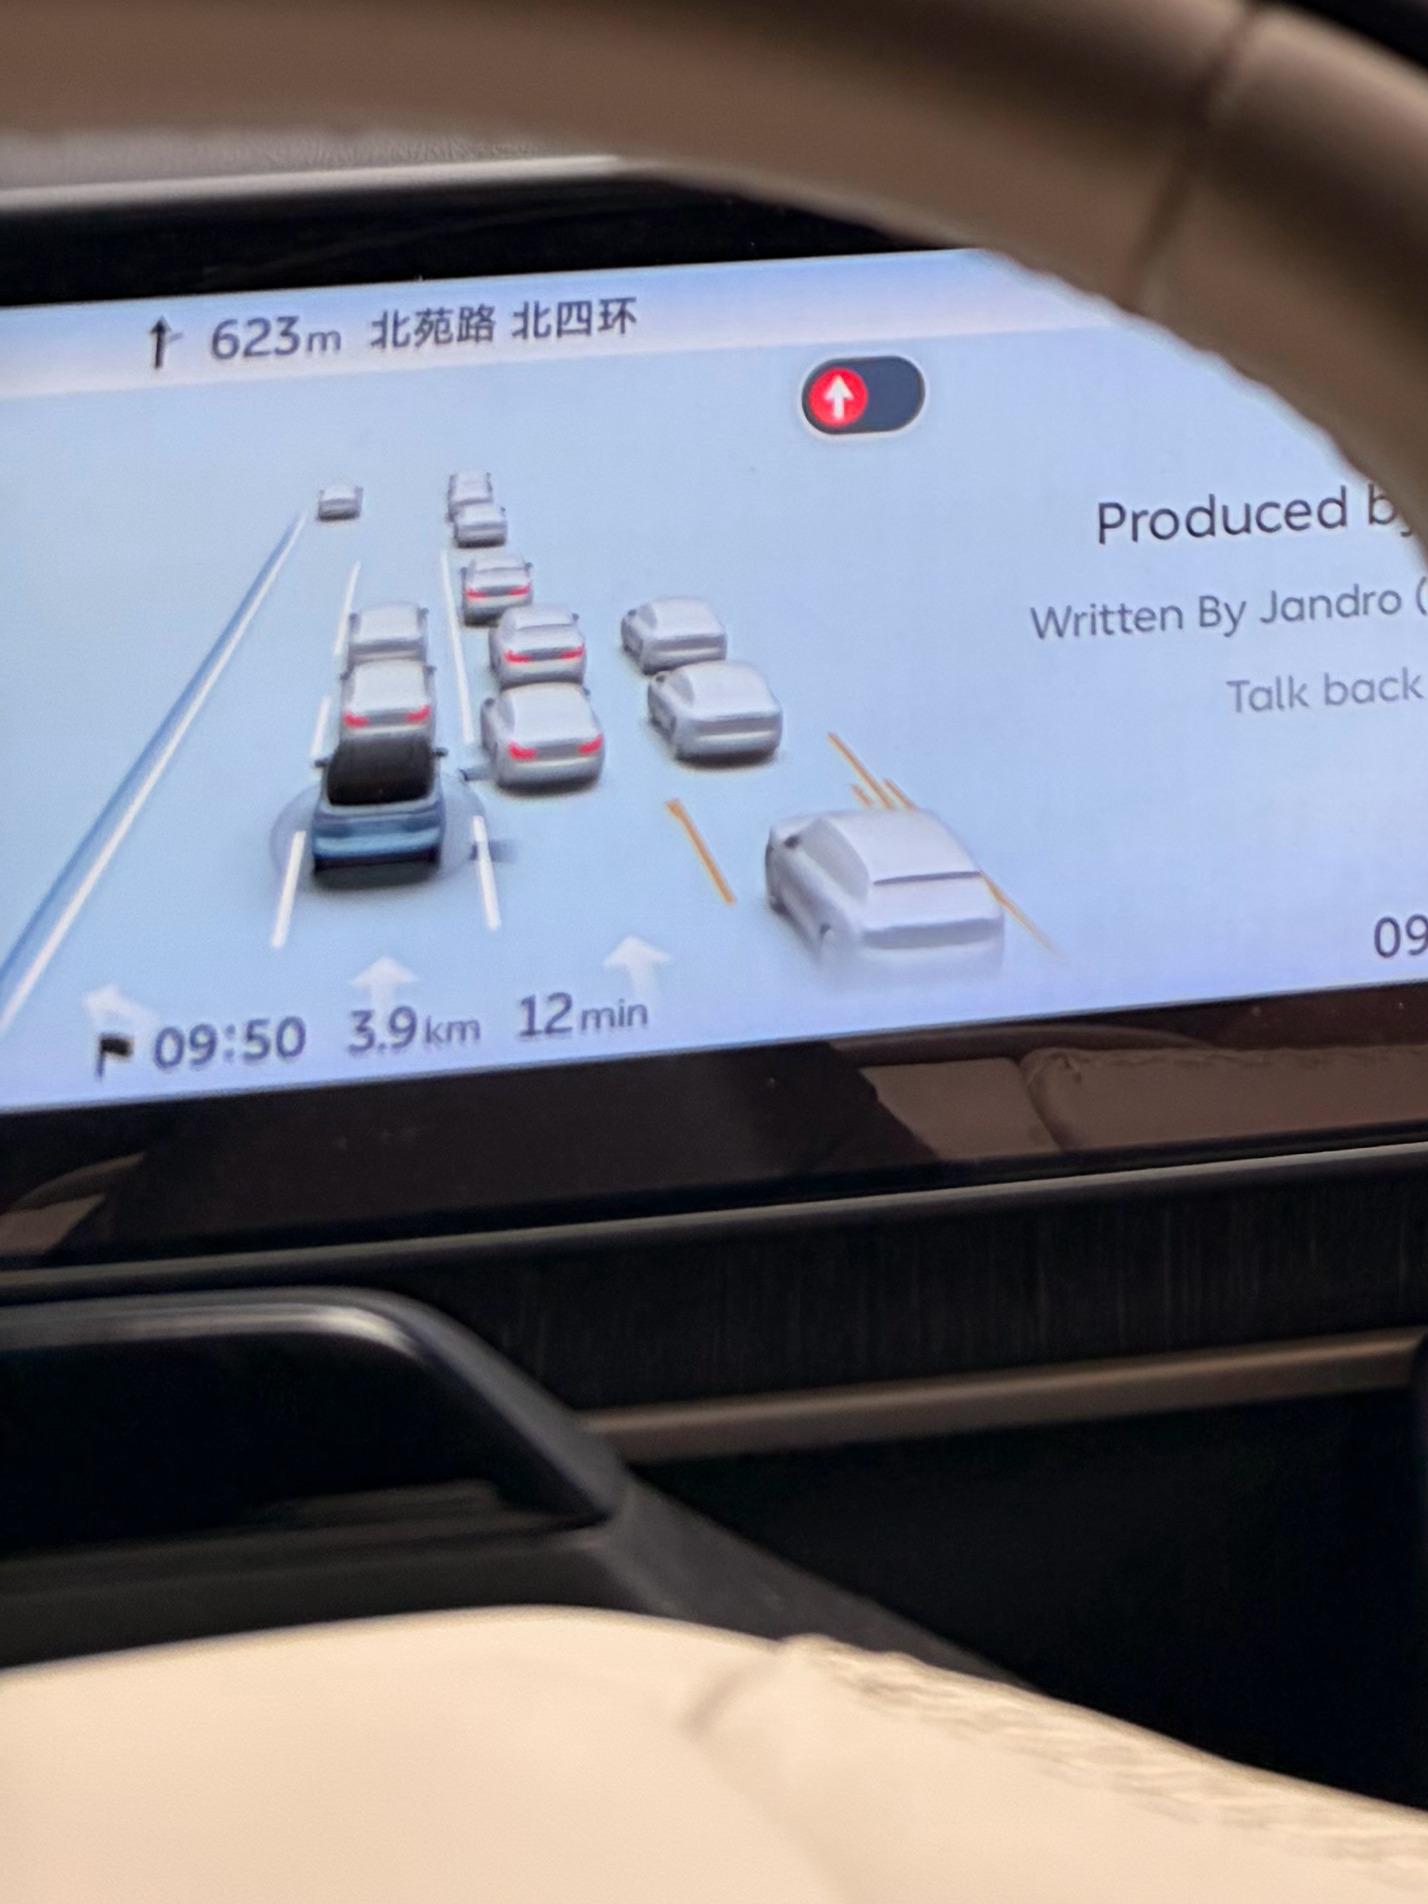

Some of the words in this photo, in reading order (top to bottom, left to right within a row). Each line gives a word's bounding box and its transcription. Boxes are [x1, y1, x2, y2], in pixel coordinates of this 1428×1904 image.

[370, 303, 496, 352] 北苑路
[512, 295, 638, 341] 北四环
[1098, 485, 1348, 545] Produced
[1030, 602, 1184, 640] Written
[1199, 594, 1247, 637] By
[1260, 583, 1402, 624] Jandro
[1226, 676, 1310, 713] Talk
[1324, 667, 1425, 706] back
[153, 1016, 307, 1071] 09:50
